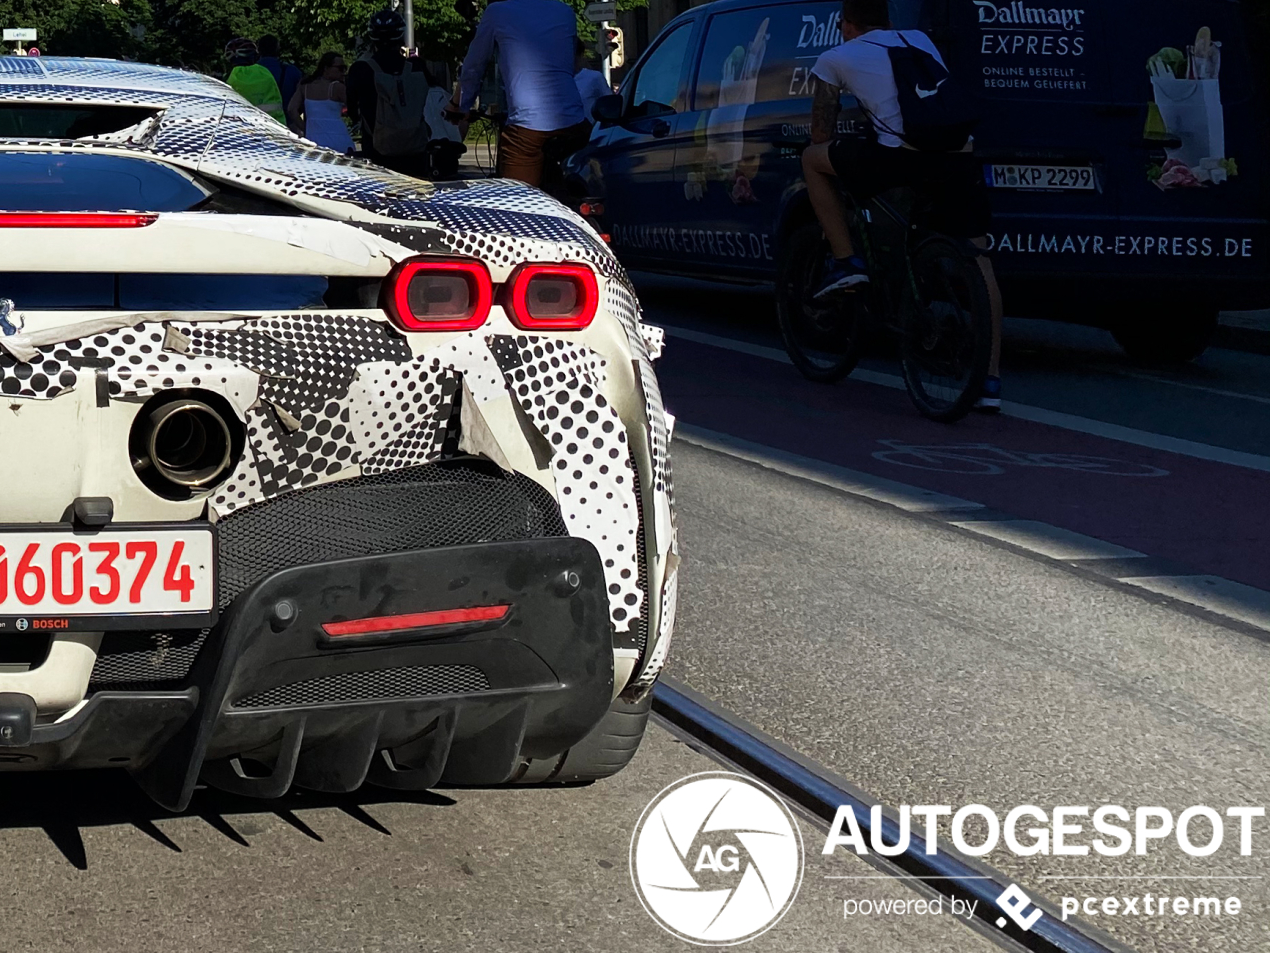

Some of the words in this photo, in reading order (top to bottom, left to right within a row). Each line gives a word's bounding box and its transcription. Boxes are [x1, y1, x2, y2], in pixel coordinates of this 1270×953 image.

[972, 0, 1085, 30] Dallmayr
[981, 35, 1084, 56] EXPRESS
[982, 67, 1025, 76] ONLINE
[1029, 68, 1075, 77] BESTELLT
[984, 78, 1030, 88] BEQUEM
[994, 167, 1006, 185] M
[1018, 168, 1042, 186] KP
[1046, 168, 1091, 186] 2299
[613, 223, 773, 260] DALLMAYR-EXPRESS.DE
[986, 232, 1252, 257] DALLMAYR-EXPRESS.DE
[33, 619, 68, 629] BOSCH
